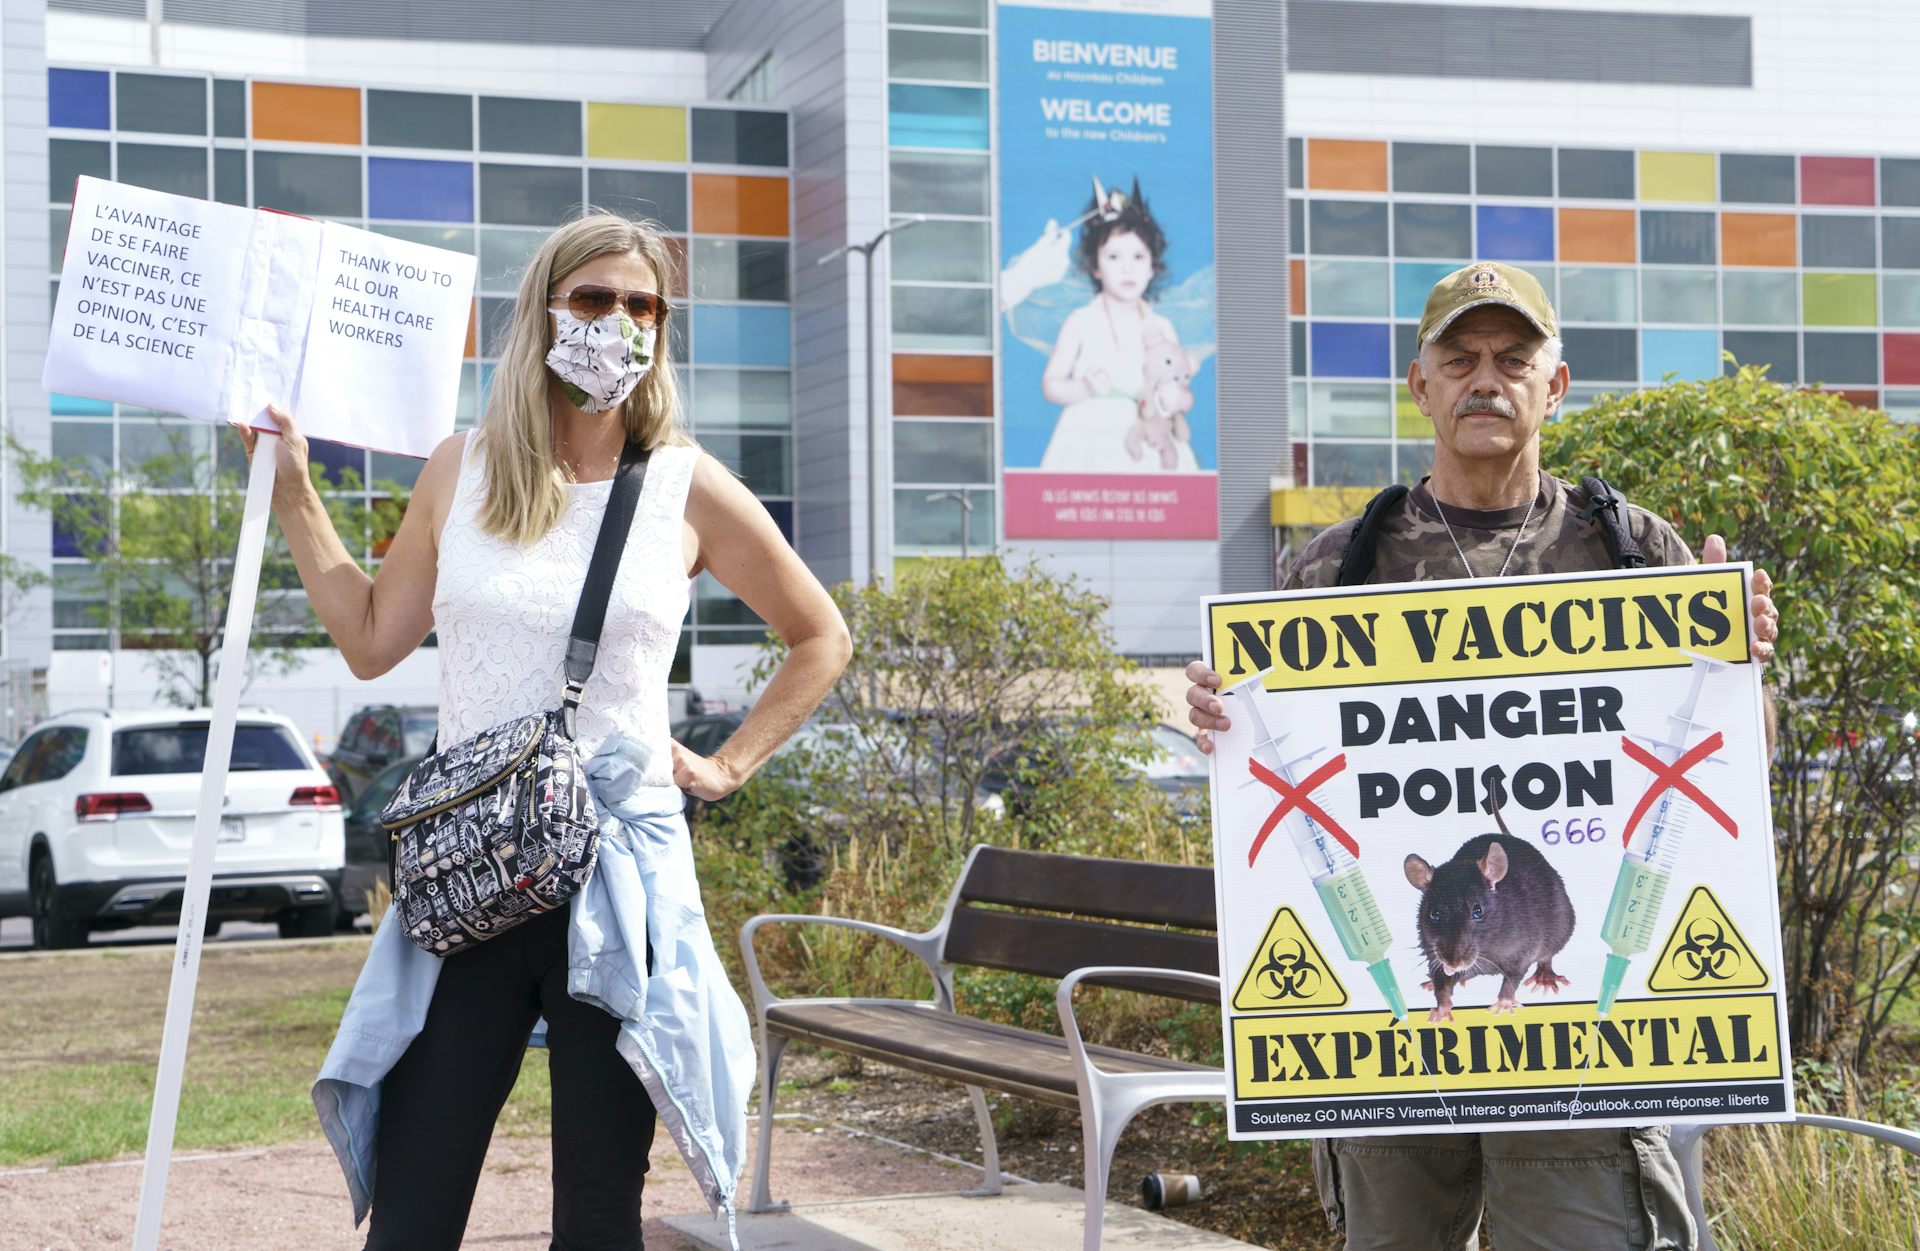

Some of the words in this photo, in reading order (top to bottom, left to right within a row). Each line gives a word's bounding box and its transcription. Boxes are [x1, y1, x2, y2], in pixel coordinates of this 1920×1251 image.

[1032, 39, 1178, 70] BIENVENUE
[1040, 97, 1171, 127] WELCOME
[1045, 127, 1058, 138] to
[1061, 128, 1080, 139] the
[1083, 130, 1107, 140] new
[95, 204, 202, 239] L'AVANTAGE
[91, 227, 114, 245] DE
[117, 233, 138, 250] SE
[142, 239, 190, 261] FAIRE
[87, 251, 174, 285] VACCINER,
[180, 271, 202, 288] CE
[339, 249, 391, 274] THANK
[395, 262, 427, 282] YOU
[432, 271, 452, 287] TO
[82, 275, 131, 297] N'EST
[134, 286, 166, 305] PAS
[171, 294, 207, 313] UNE
[335, 273, 360, 292] ALL
[365, 281, 399, 300] OUR
[77, 300, 156, 330] OPINION,
[162, 317, 208, 337] C'EST
[332, 297, 390, 322] HEALTH
[394, 311, 434, 331] CARE
[73, 323, 96, 340] DE
[100, 329, 120, 346] LA
[125, 334, 196, 360] SCIENCE
[329, 319, 403, 348] WORKERS
[1226, 612, 1379, 675] NON
[1401, 590, 1731, 663] VACCINS
[1339, 686, 1626, 747] DANGER
[1357, 759, 1614, 819] POISON
[1541, 817, 1607, 846] 666
[1248, 1014, 1768, 1082] EXPÉRIMENTAL
[1250, 1112, 1312, 1125] Soutenez
[1315, 1109, 1337, 1123] GO
[1341, 1107, 1395, 1121] MANIFS
[1398, 1105, 1457, 1119] Virement
[1460, 1103, 1506, 1116] Interac
[1508, 1098, 1663, 1116] gomanifs@outlook.com
[1666, 1094, 1725, 1111] réponse:
[1728, 1092, 1769, 1106] liberte
